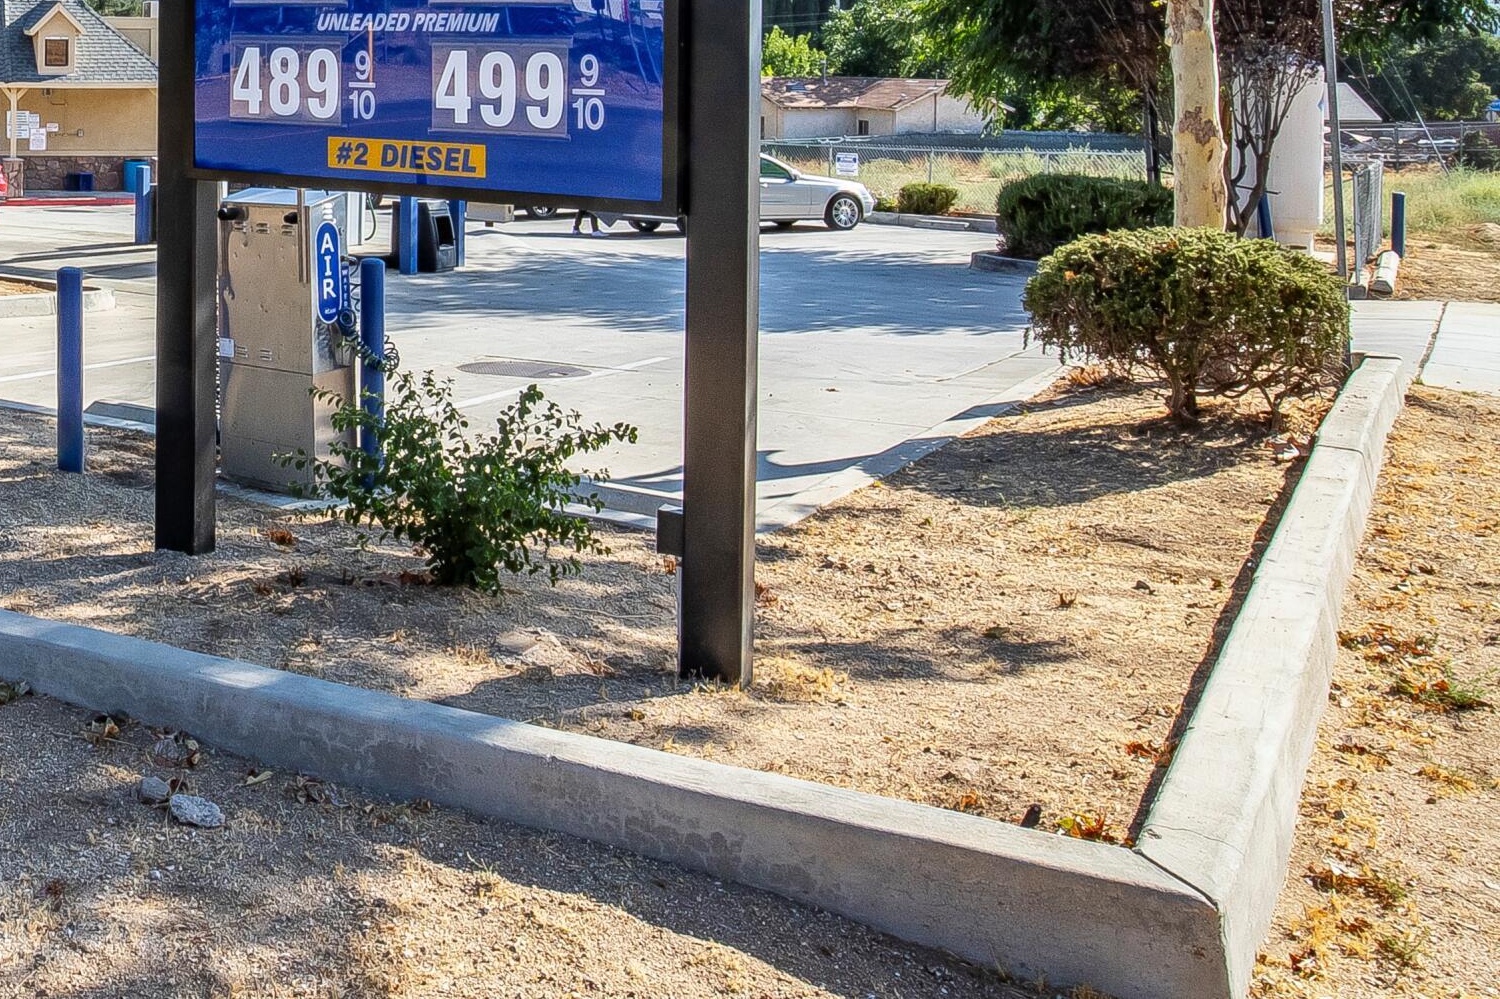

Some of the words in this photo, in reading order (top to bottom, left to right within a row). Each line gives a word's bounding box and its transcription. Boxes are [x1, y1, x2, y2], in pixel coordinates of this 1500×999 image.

[317, 12, 410, 32] UNLEADED
[412, 12, 500, 33] PREMIUM
[354, 51, 372, 80] 9
[580, 54, 600, 87] 9
[232, 46, 340, 121] 489
[435, 50, 566, 128] 499
[348, 89, 376, 120] 10
[572, 96, 605, 131] 10
[335, 142, 368, 165] #2
[381, 143, 477, 174] DIESEL
[320, 232, 337, 301] AIR
